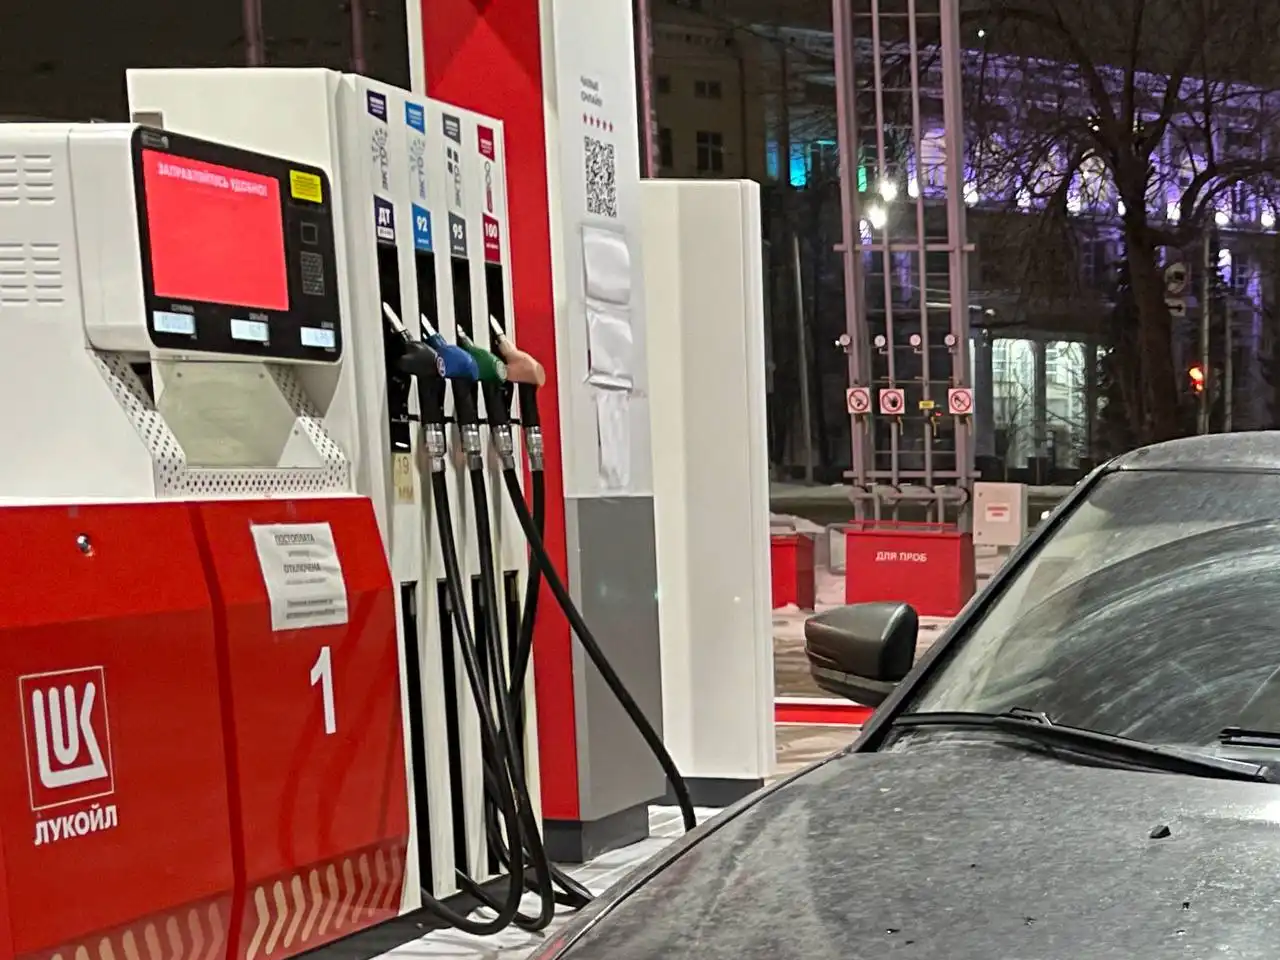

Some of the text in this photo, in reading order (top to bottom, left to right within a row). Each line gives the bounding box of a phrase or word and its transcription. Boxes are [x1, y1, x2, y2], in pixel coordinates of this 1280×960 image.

[416, 215, 428, 232] 92
[452, 223, 464, 240] 95
[484, 222, 498, 239] 100
[875, 551, 928, 562] ДЛЯ ПРОБ
[310, 646, 336, 734] 1
[34, 803, 118, 845] ЛУКОЙЛ
